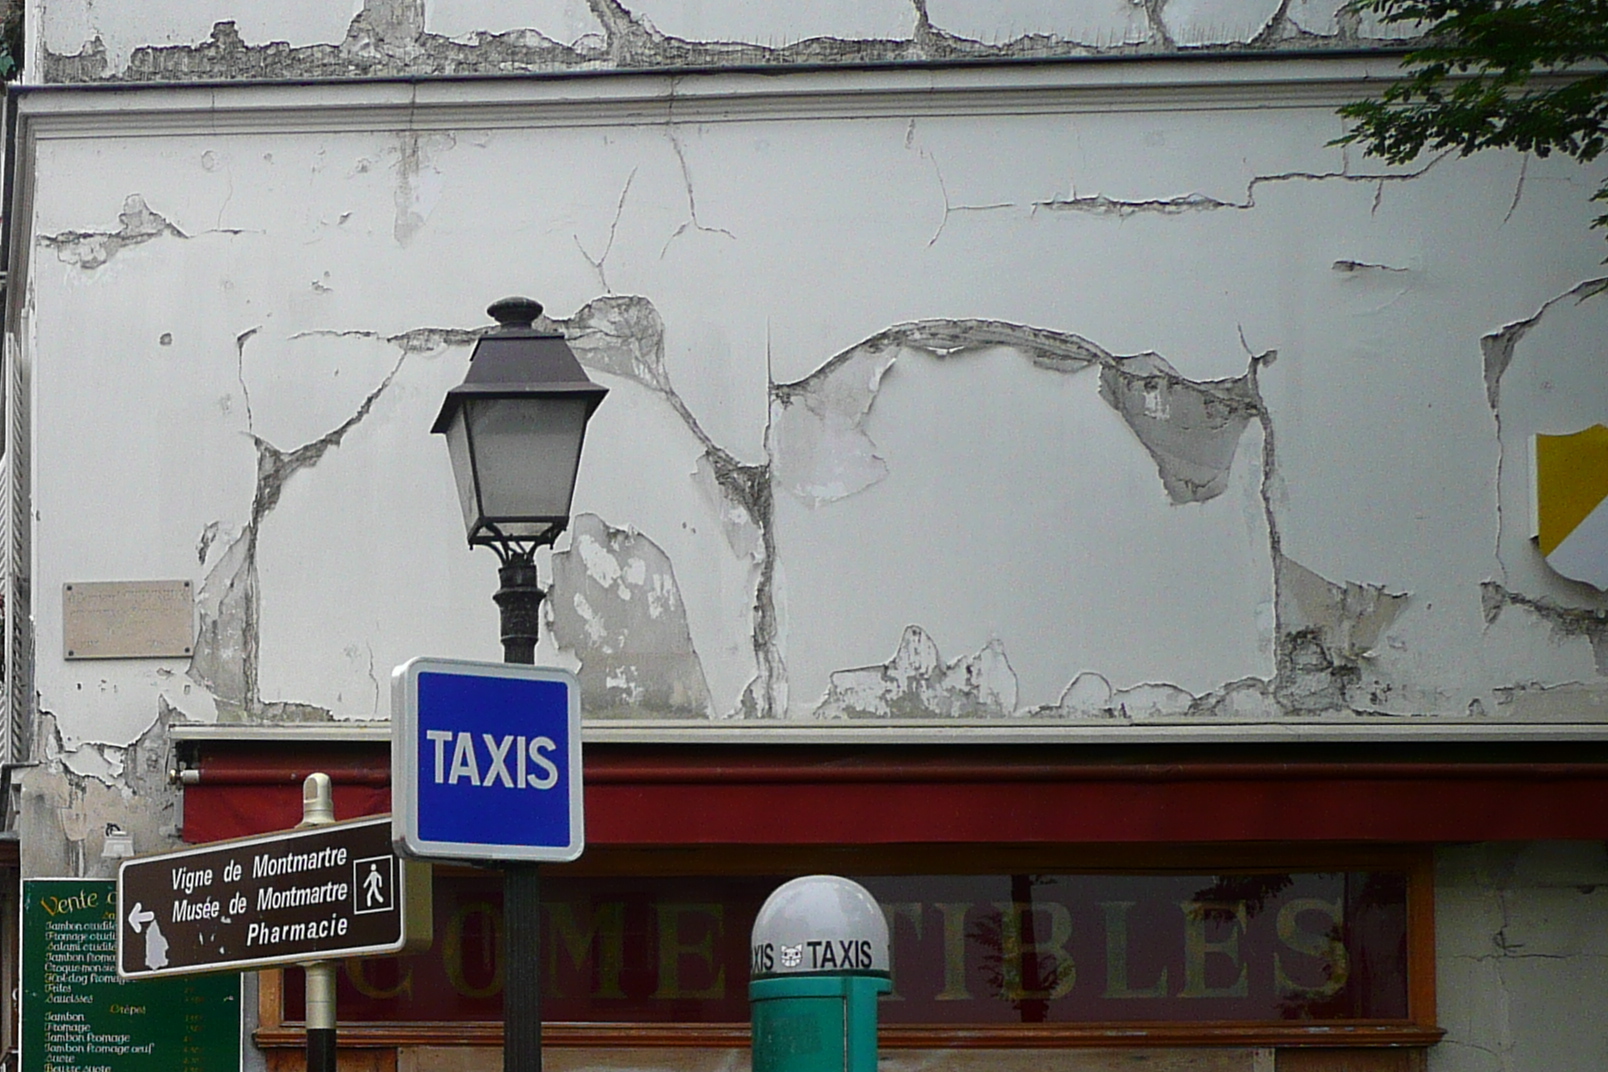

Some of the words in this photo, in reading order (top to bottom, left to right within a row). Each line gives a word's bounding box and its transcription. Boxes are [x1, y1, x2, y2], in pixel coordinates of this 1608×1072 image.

[426, 729, 559, 790] TAXIS
[172, 868, 213, 895] Vigne
[223, 859, 242, 883] de
[252, 847, 347, 879] Montmartre
[172, 896, 220, 923] Musée
[228, 891, 247, 915] de
[256, 881, 348, 911] Montmartre
[246, 913, 348, 947] Pharmacie
[344, 897, 1348, 1001] OMETIBLES
[806, 940, 872, 969] TAXIS
